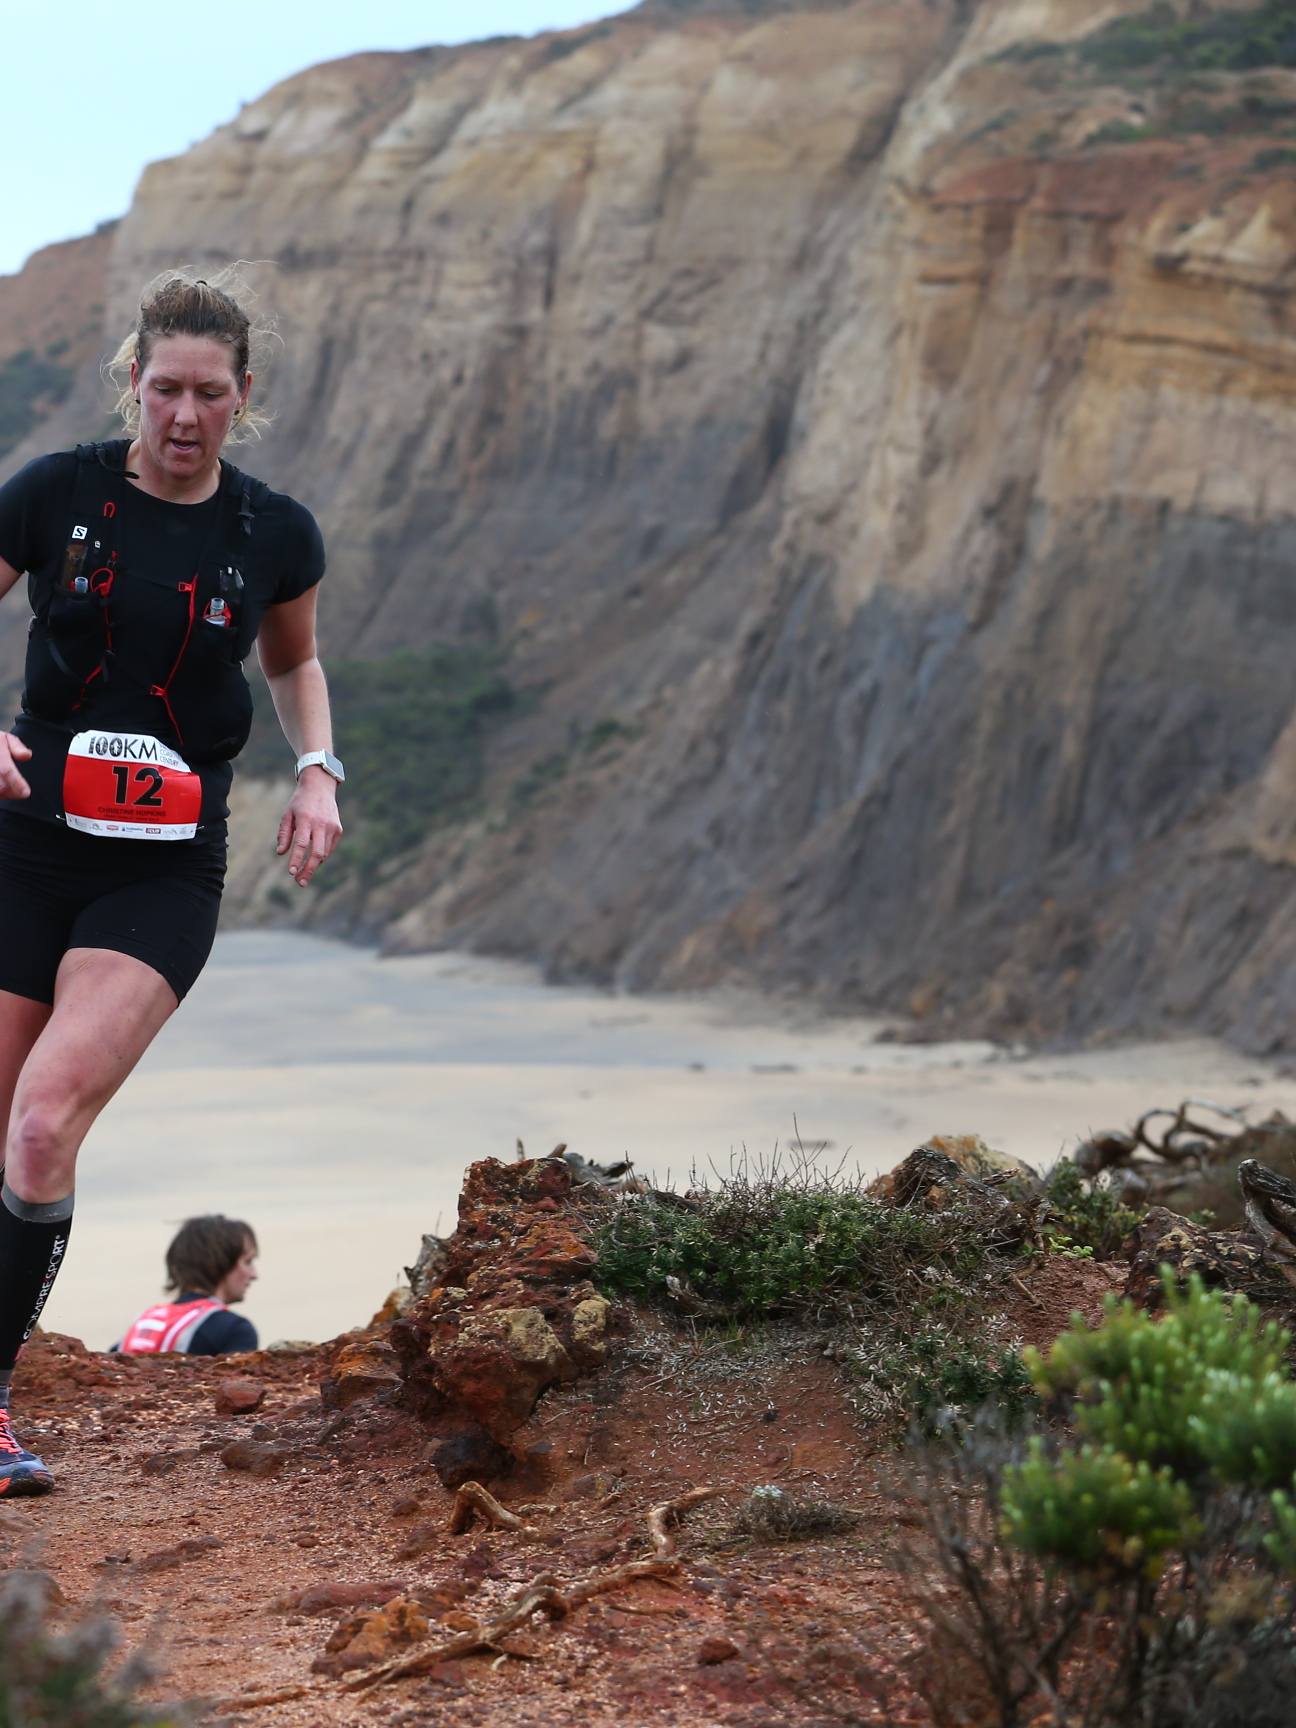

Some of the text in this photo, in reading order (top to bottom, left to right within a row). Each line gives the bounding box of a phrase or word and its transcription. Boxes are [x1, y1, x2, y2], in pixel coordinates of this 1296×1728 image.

[88, 736, 158, 760] 100KM
[112, 765, 164, 807] 12
[97, 806, 167, 817] CHRISTINE HOPKINS
